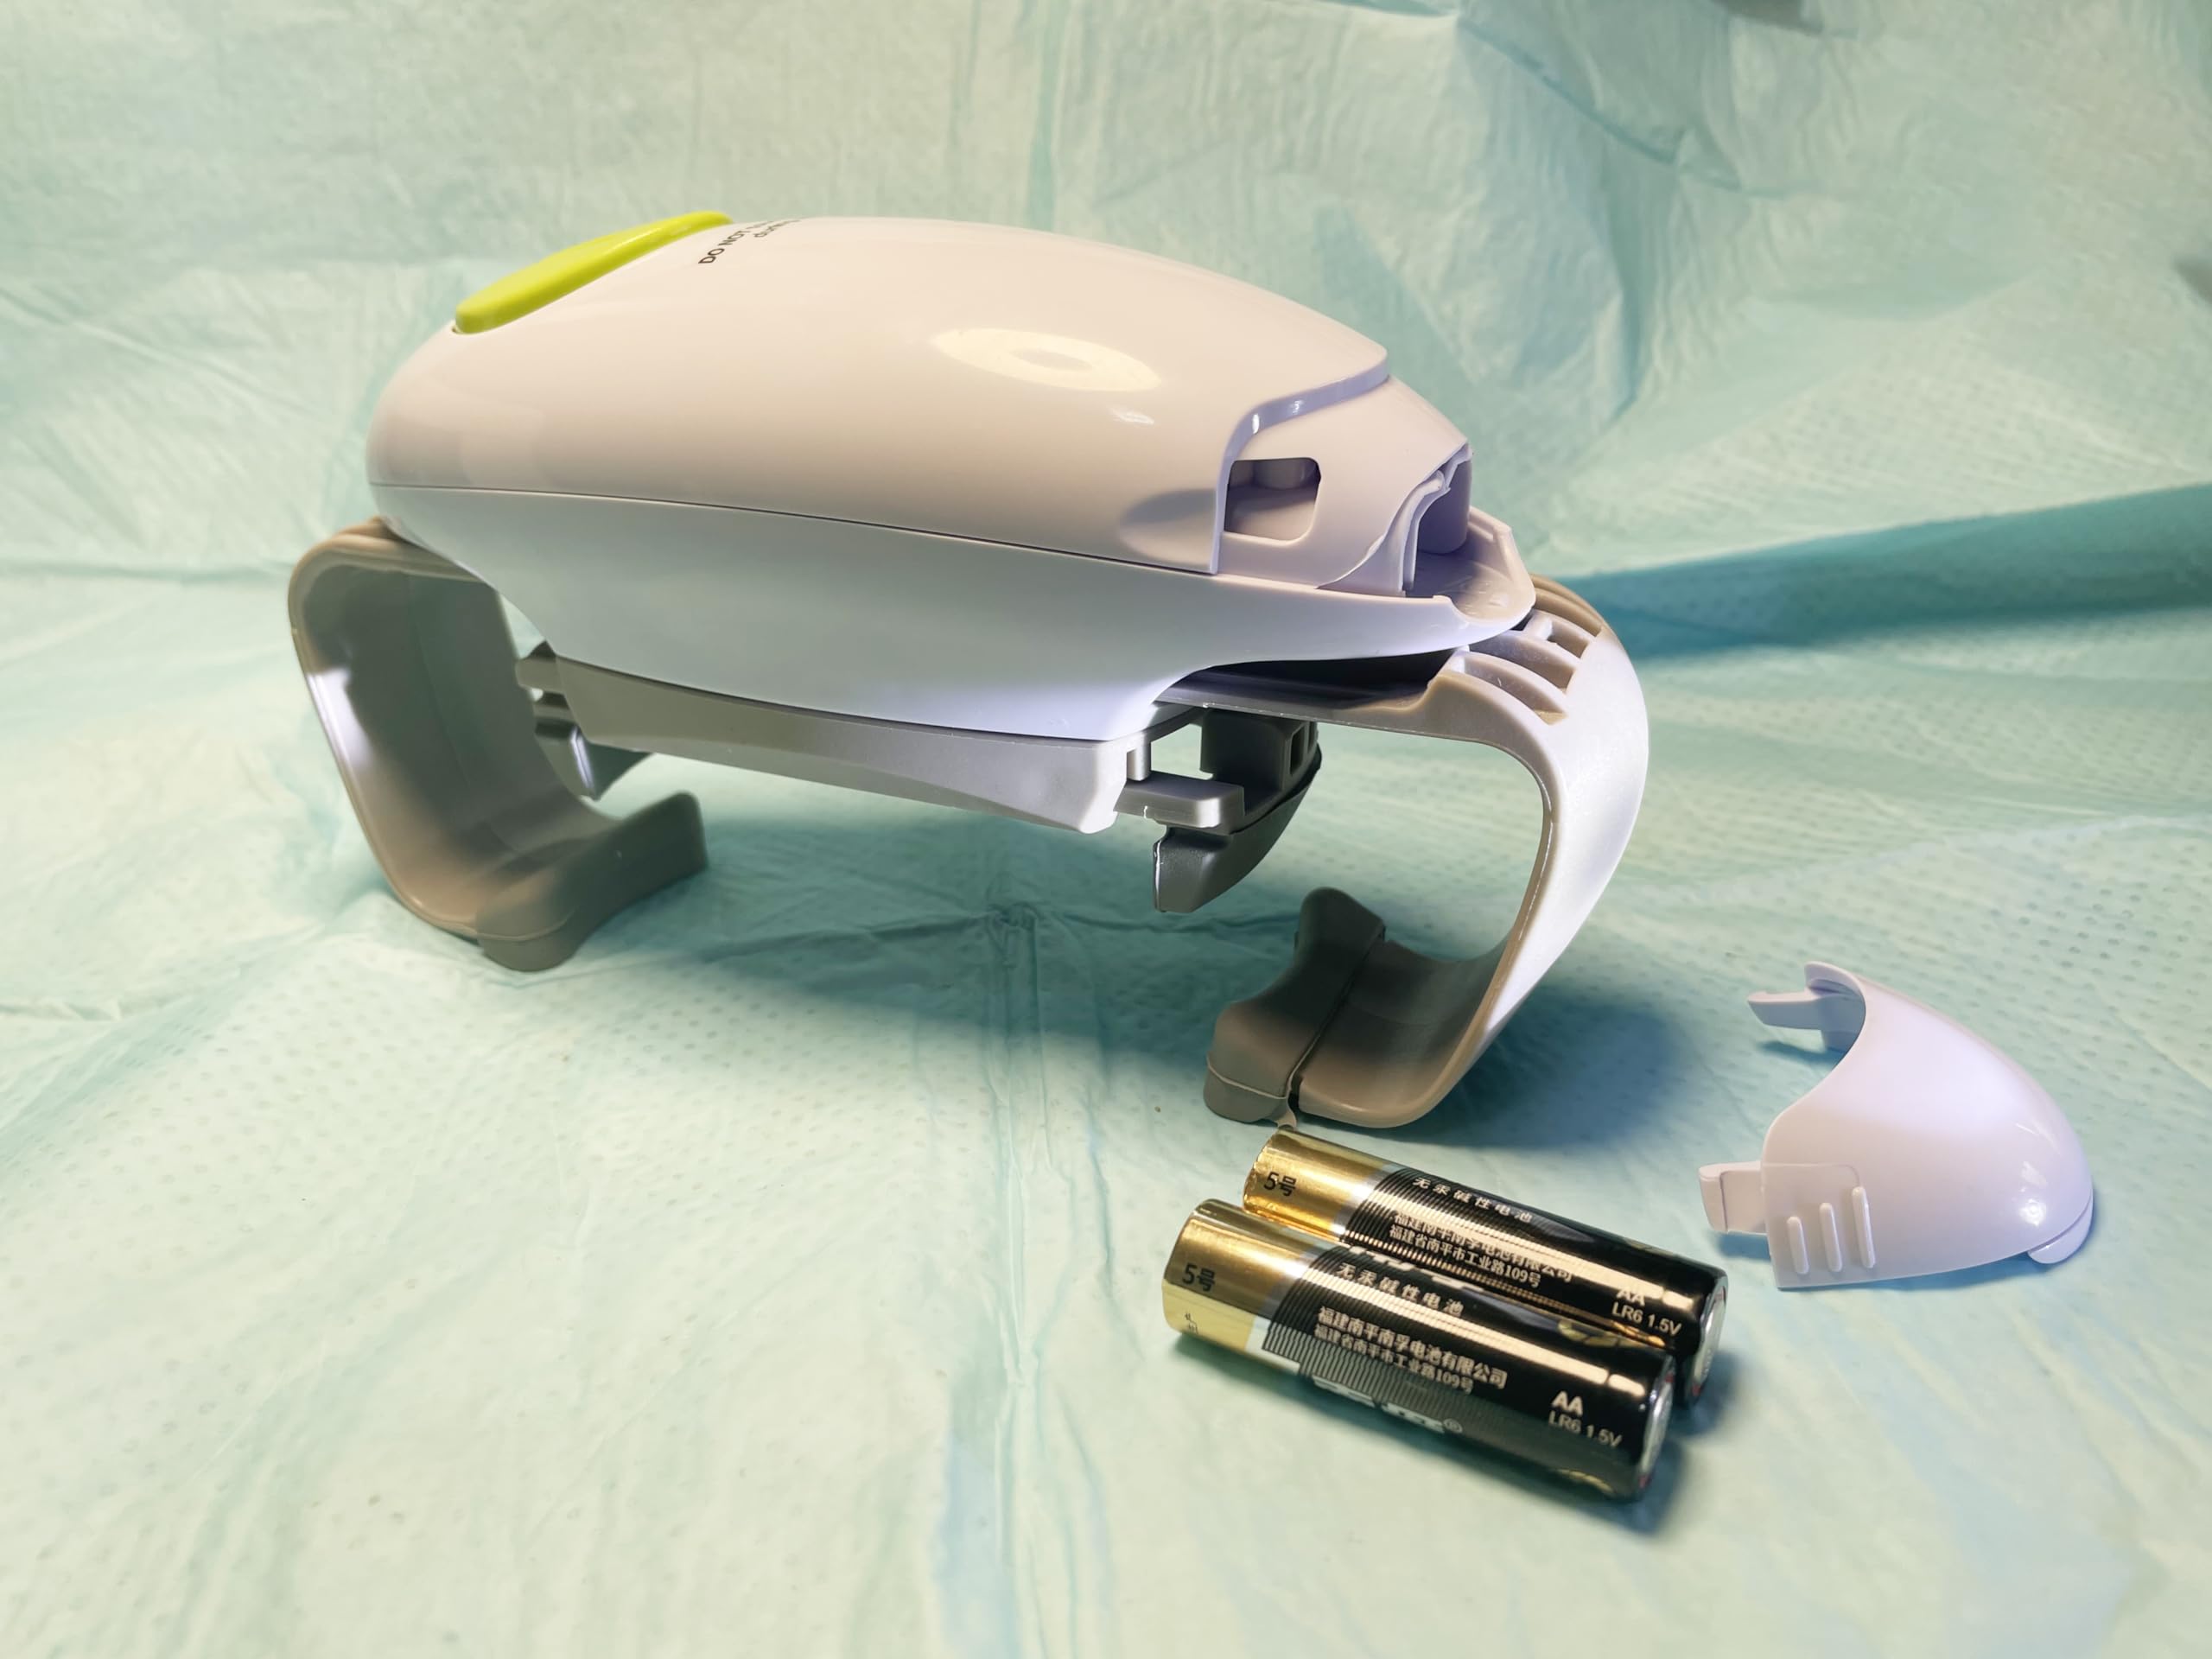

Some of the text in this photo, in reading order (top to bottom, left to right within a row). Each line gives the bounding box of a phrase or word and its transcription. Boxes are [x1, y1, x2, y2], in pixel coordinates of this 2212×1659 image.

[698, 230, 751, 264] DO NOT
[1263, 1172, 1297, 1197] 5号
[1412, 1177, 1533, 1224] 无汞碱性电池
[1182, 1263, 1216, 1292] 5号
[1337, 1262, 1465, 1317] 无汞碱性电池
[1616, 1287, 1645, 1306] AA
[1611, 1301, 1682, 1336] LR6 1.5V
[1318, 1306, 1508, 1389] 福建南平南孚电池有限公司
[1551, 1390, 1583, 1417] AA
[1548, 1410, 1623, 1447] LR6 1.5V
